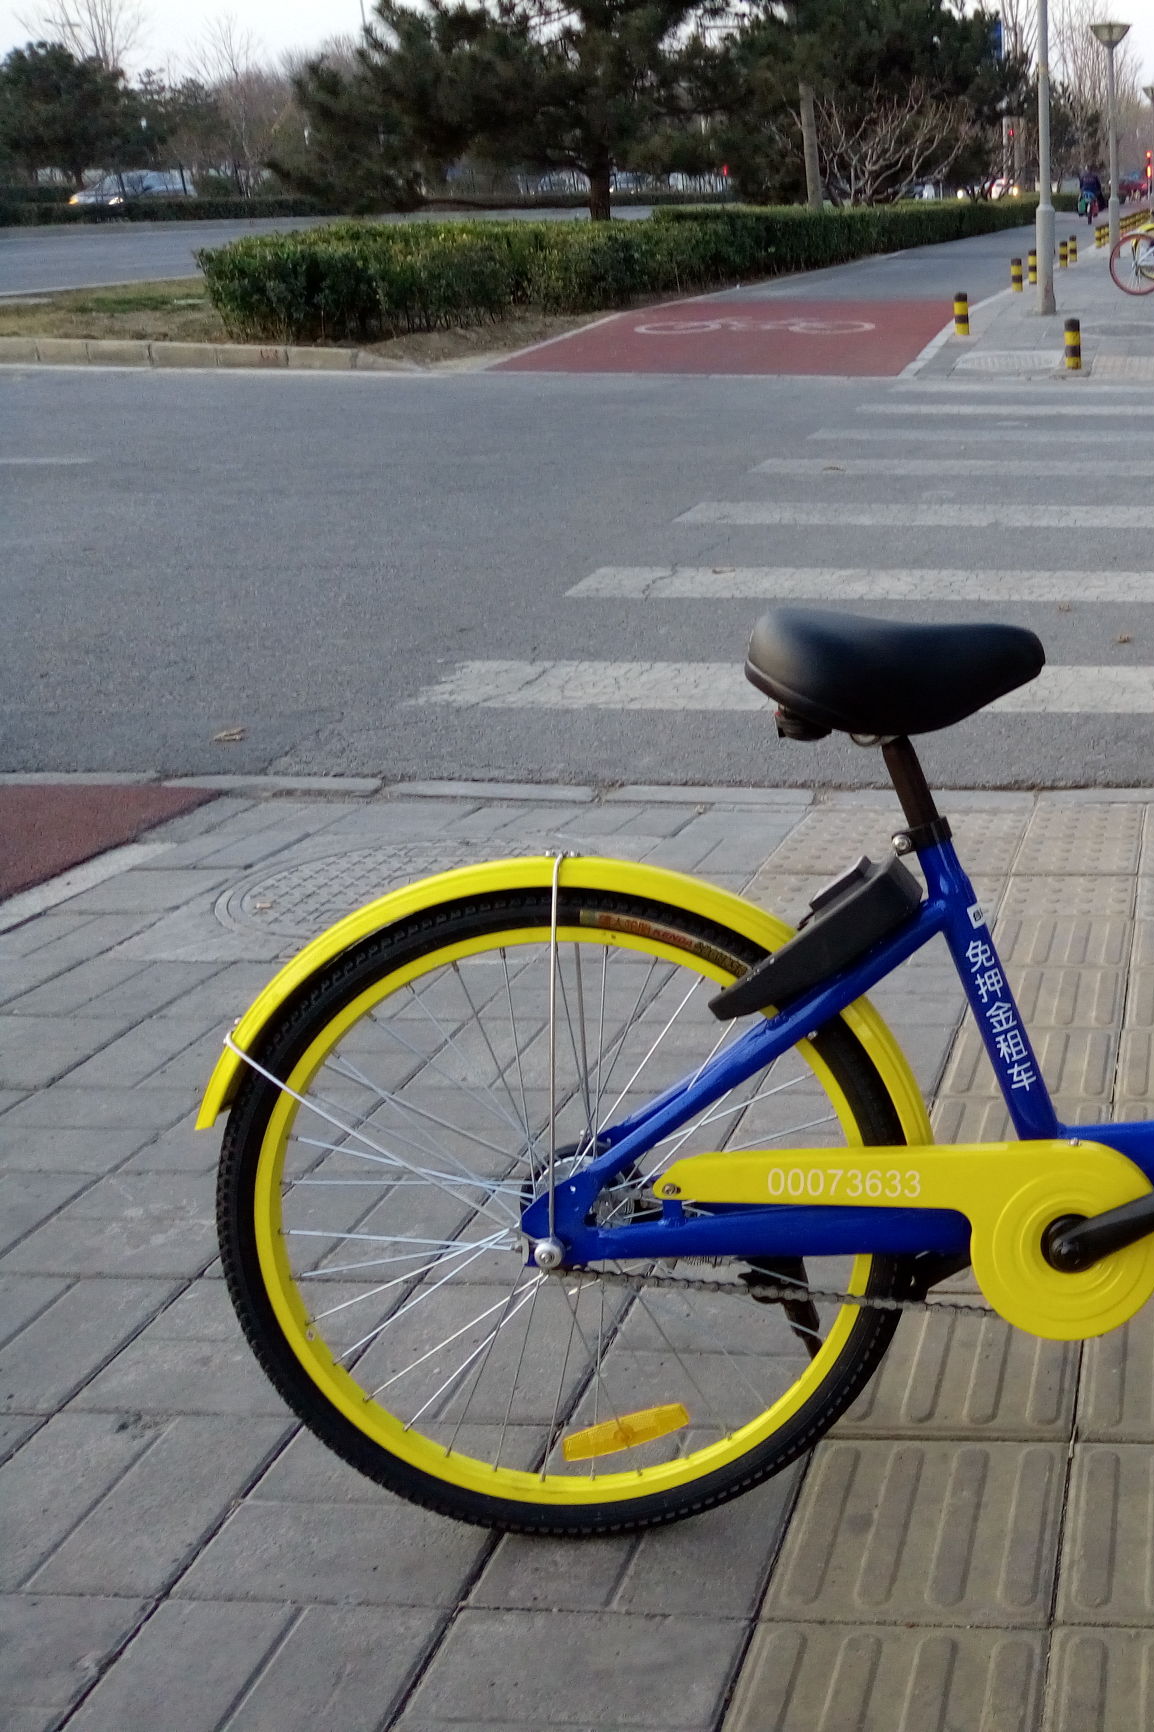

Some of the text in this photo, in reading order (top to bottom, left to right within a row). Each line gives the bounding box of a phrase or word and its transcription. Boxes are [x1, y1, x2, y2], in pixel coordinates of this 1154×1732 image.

[965, 940, 1037, 1092] 免押金租车
[767, 1167, 921, 1197] 00073633
